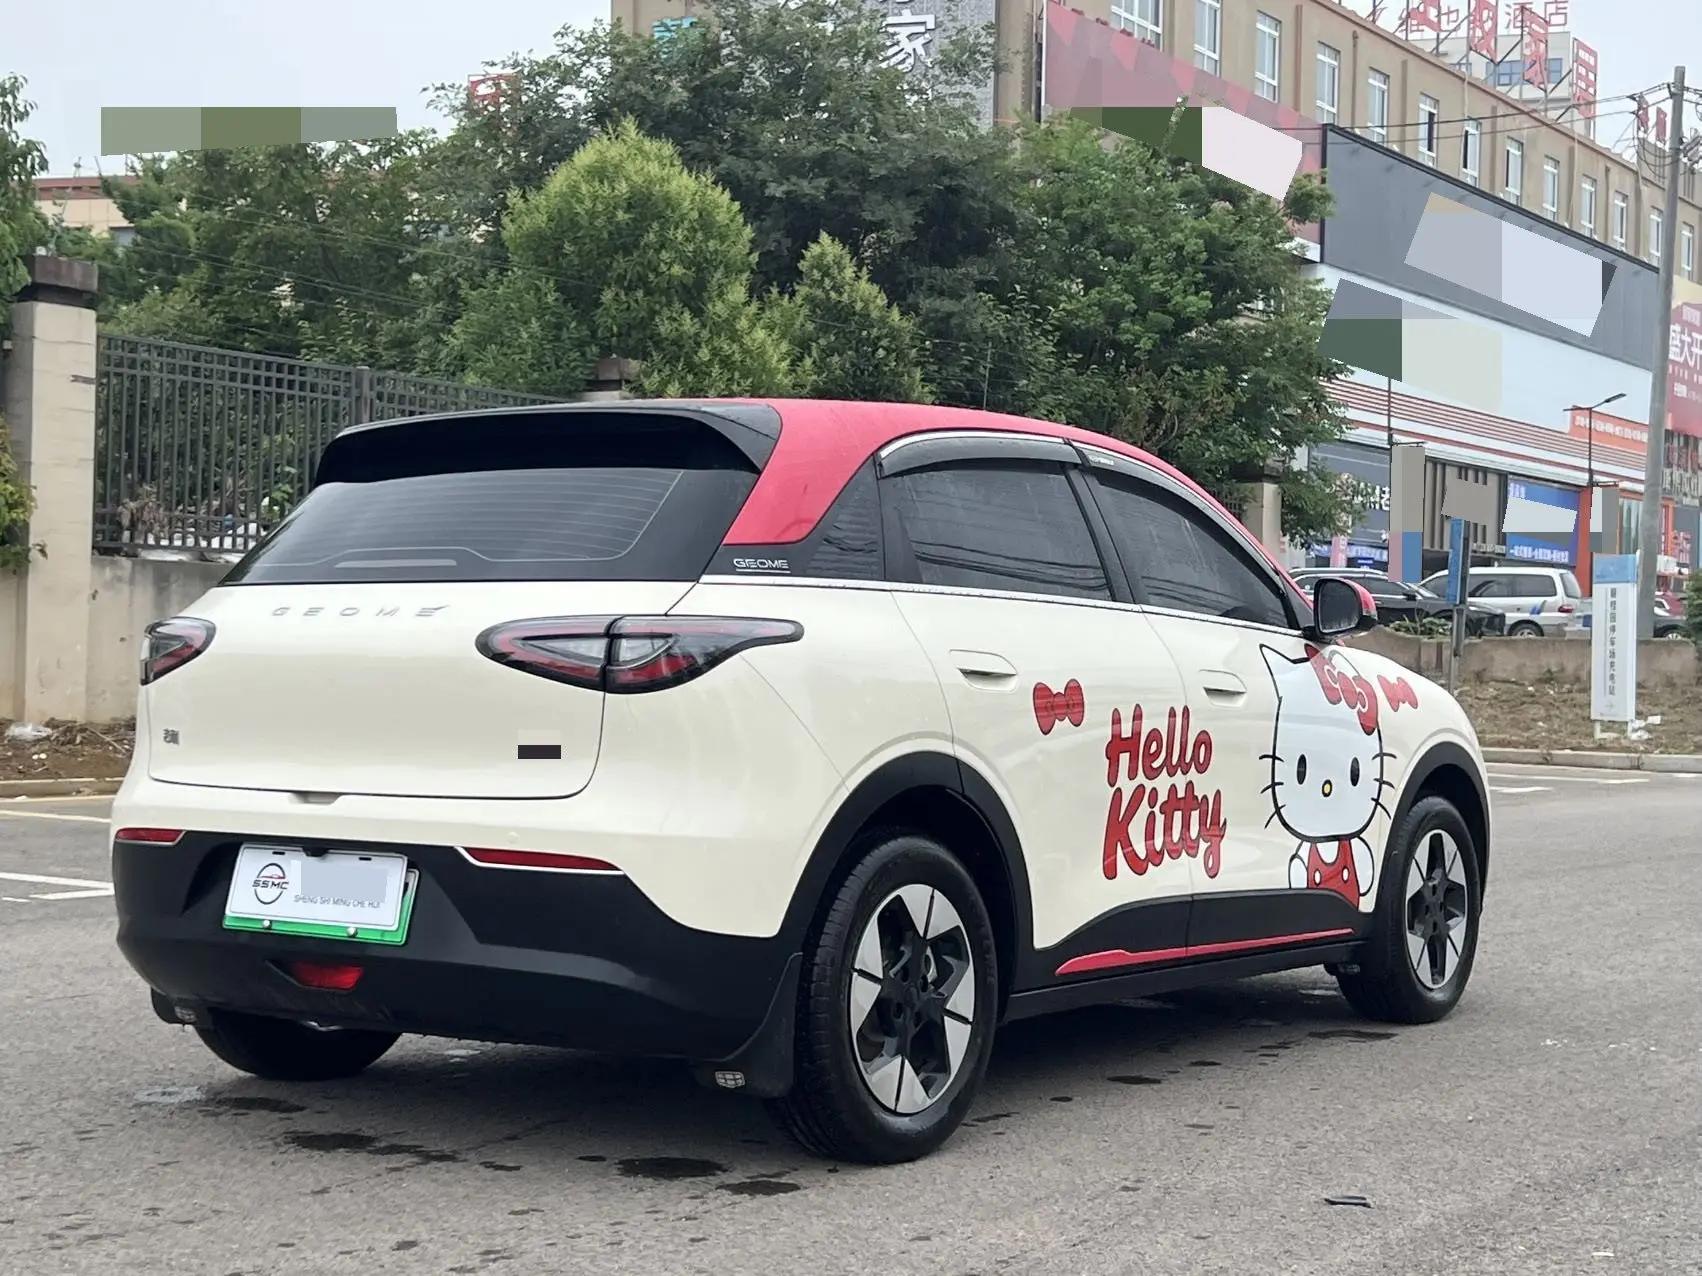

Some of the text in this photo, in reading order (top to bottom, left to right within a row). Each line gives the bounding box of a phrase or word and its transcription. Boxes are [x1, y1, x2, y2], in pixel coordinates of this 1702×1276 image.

[878, 9, 936, 73] 家
[733, 558, 789, 569] GEOME
[271, 604, 451, 617] GEOME
[1105, 703, 1213, 787] Hello
[1103, 780, 1227, 880] Kitty
[252, 879, 289, 890] SSMC
